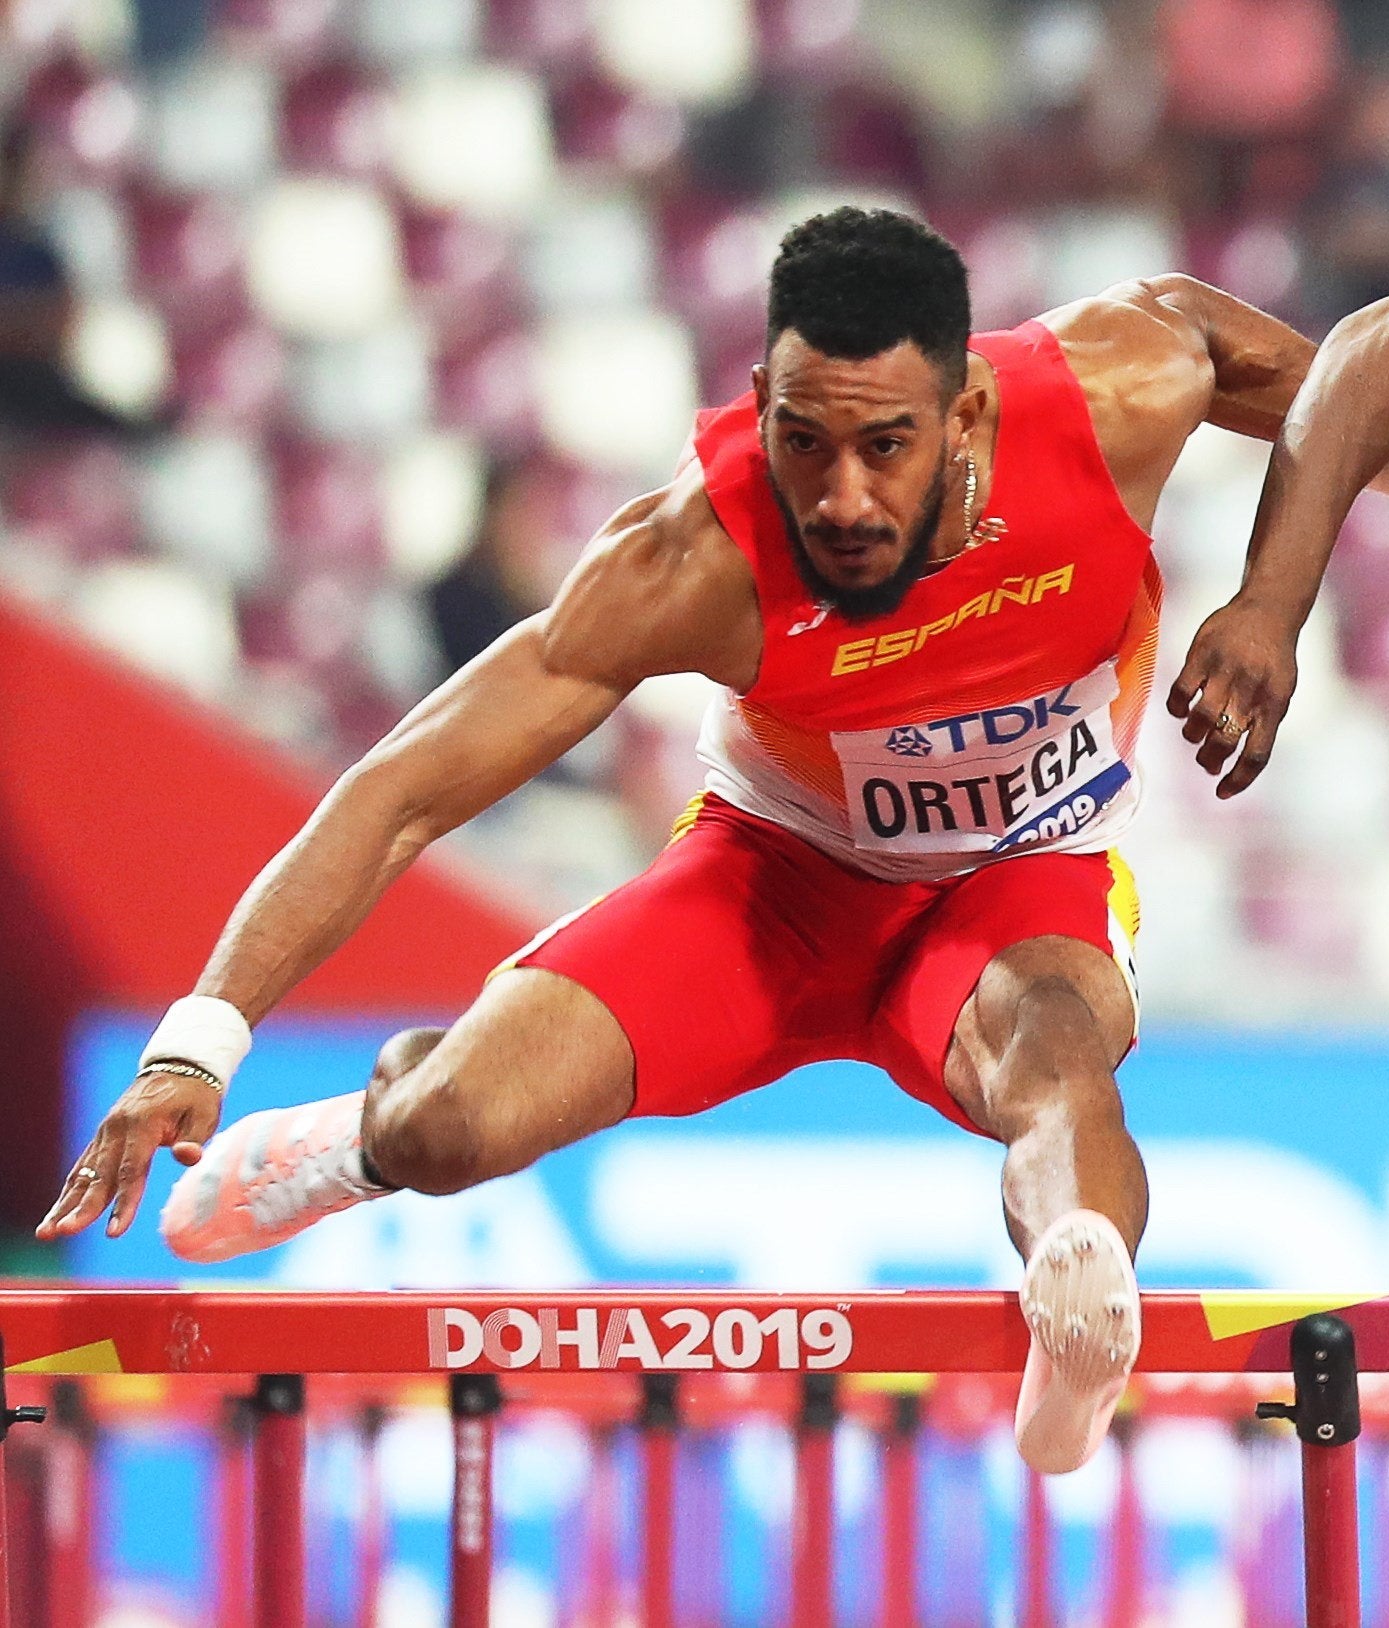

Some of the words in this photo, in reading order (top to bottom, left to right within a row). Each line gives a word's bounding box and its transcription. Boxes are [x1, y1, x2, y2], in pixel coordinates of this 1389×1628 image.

[830, 563, 1075, 677] ESPAÑA
[928, 684, 1081, 753] TDK
[862, 718, 1099, 839] ORTEGA
